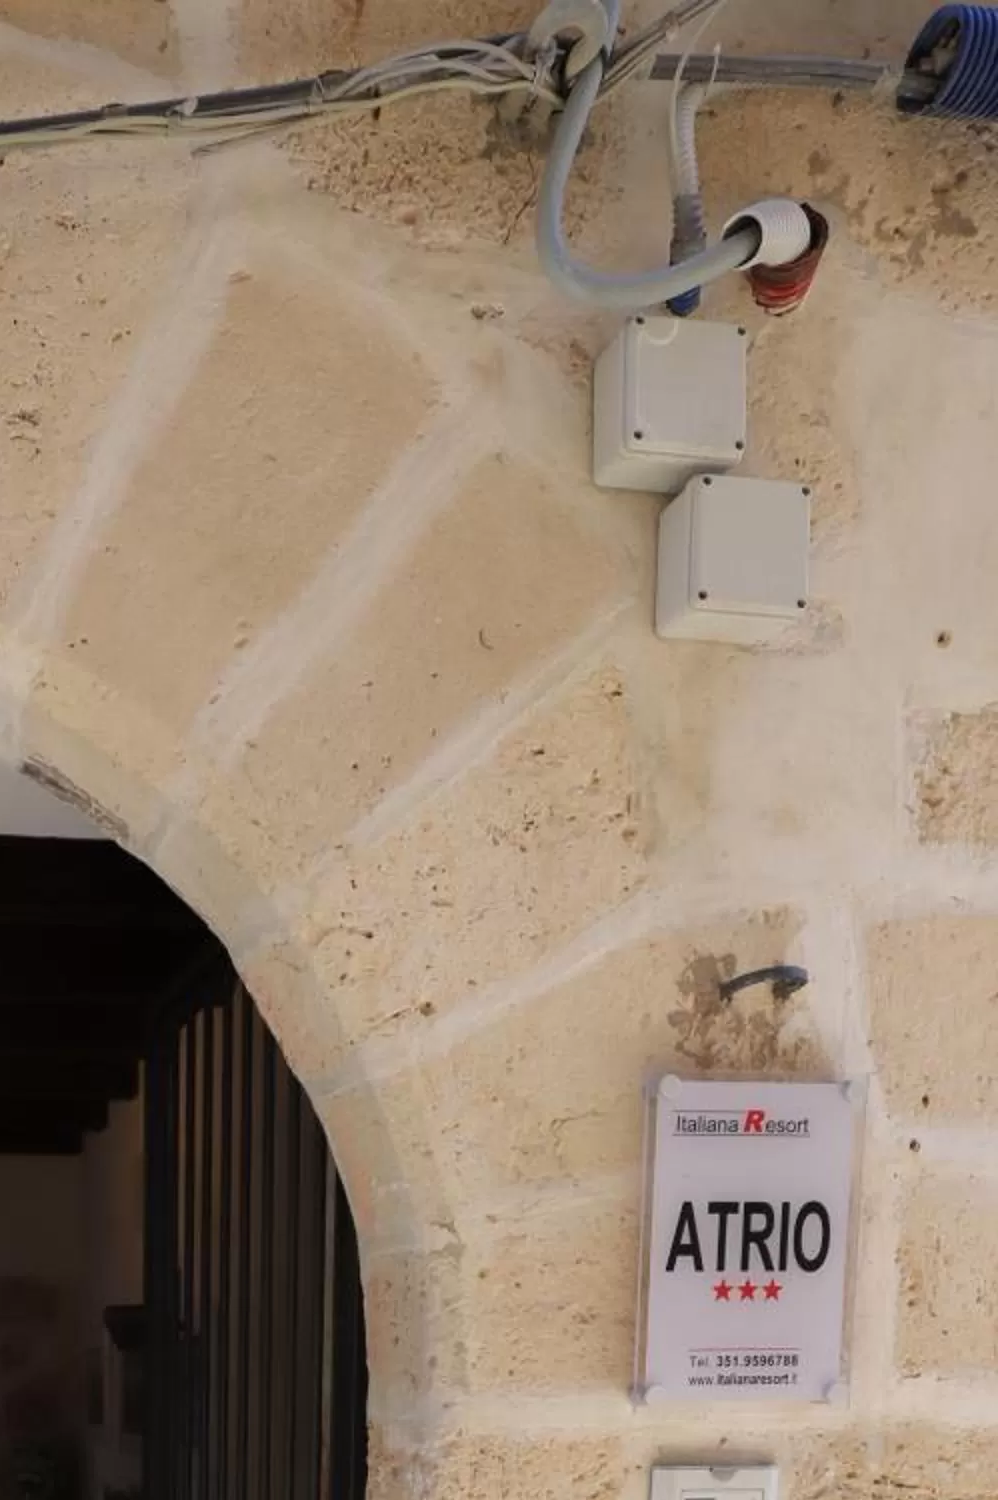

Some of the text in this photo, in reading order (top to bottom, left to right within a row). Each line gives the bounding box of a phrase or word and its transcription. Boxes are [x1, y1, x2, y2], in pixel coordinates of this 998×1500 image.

[676, 1110, 809, 1133] Italiana Resort
[665, 1200, 831, 1273] ATRIO
